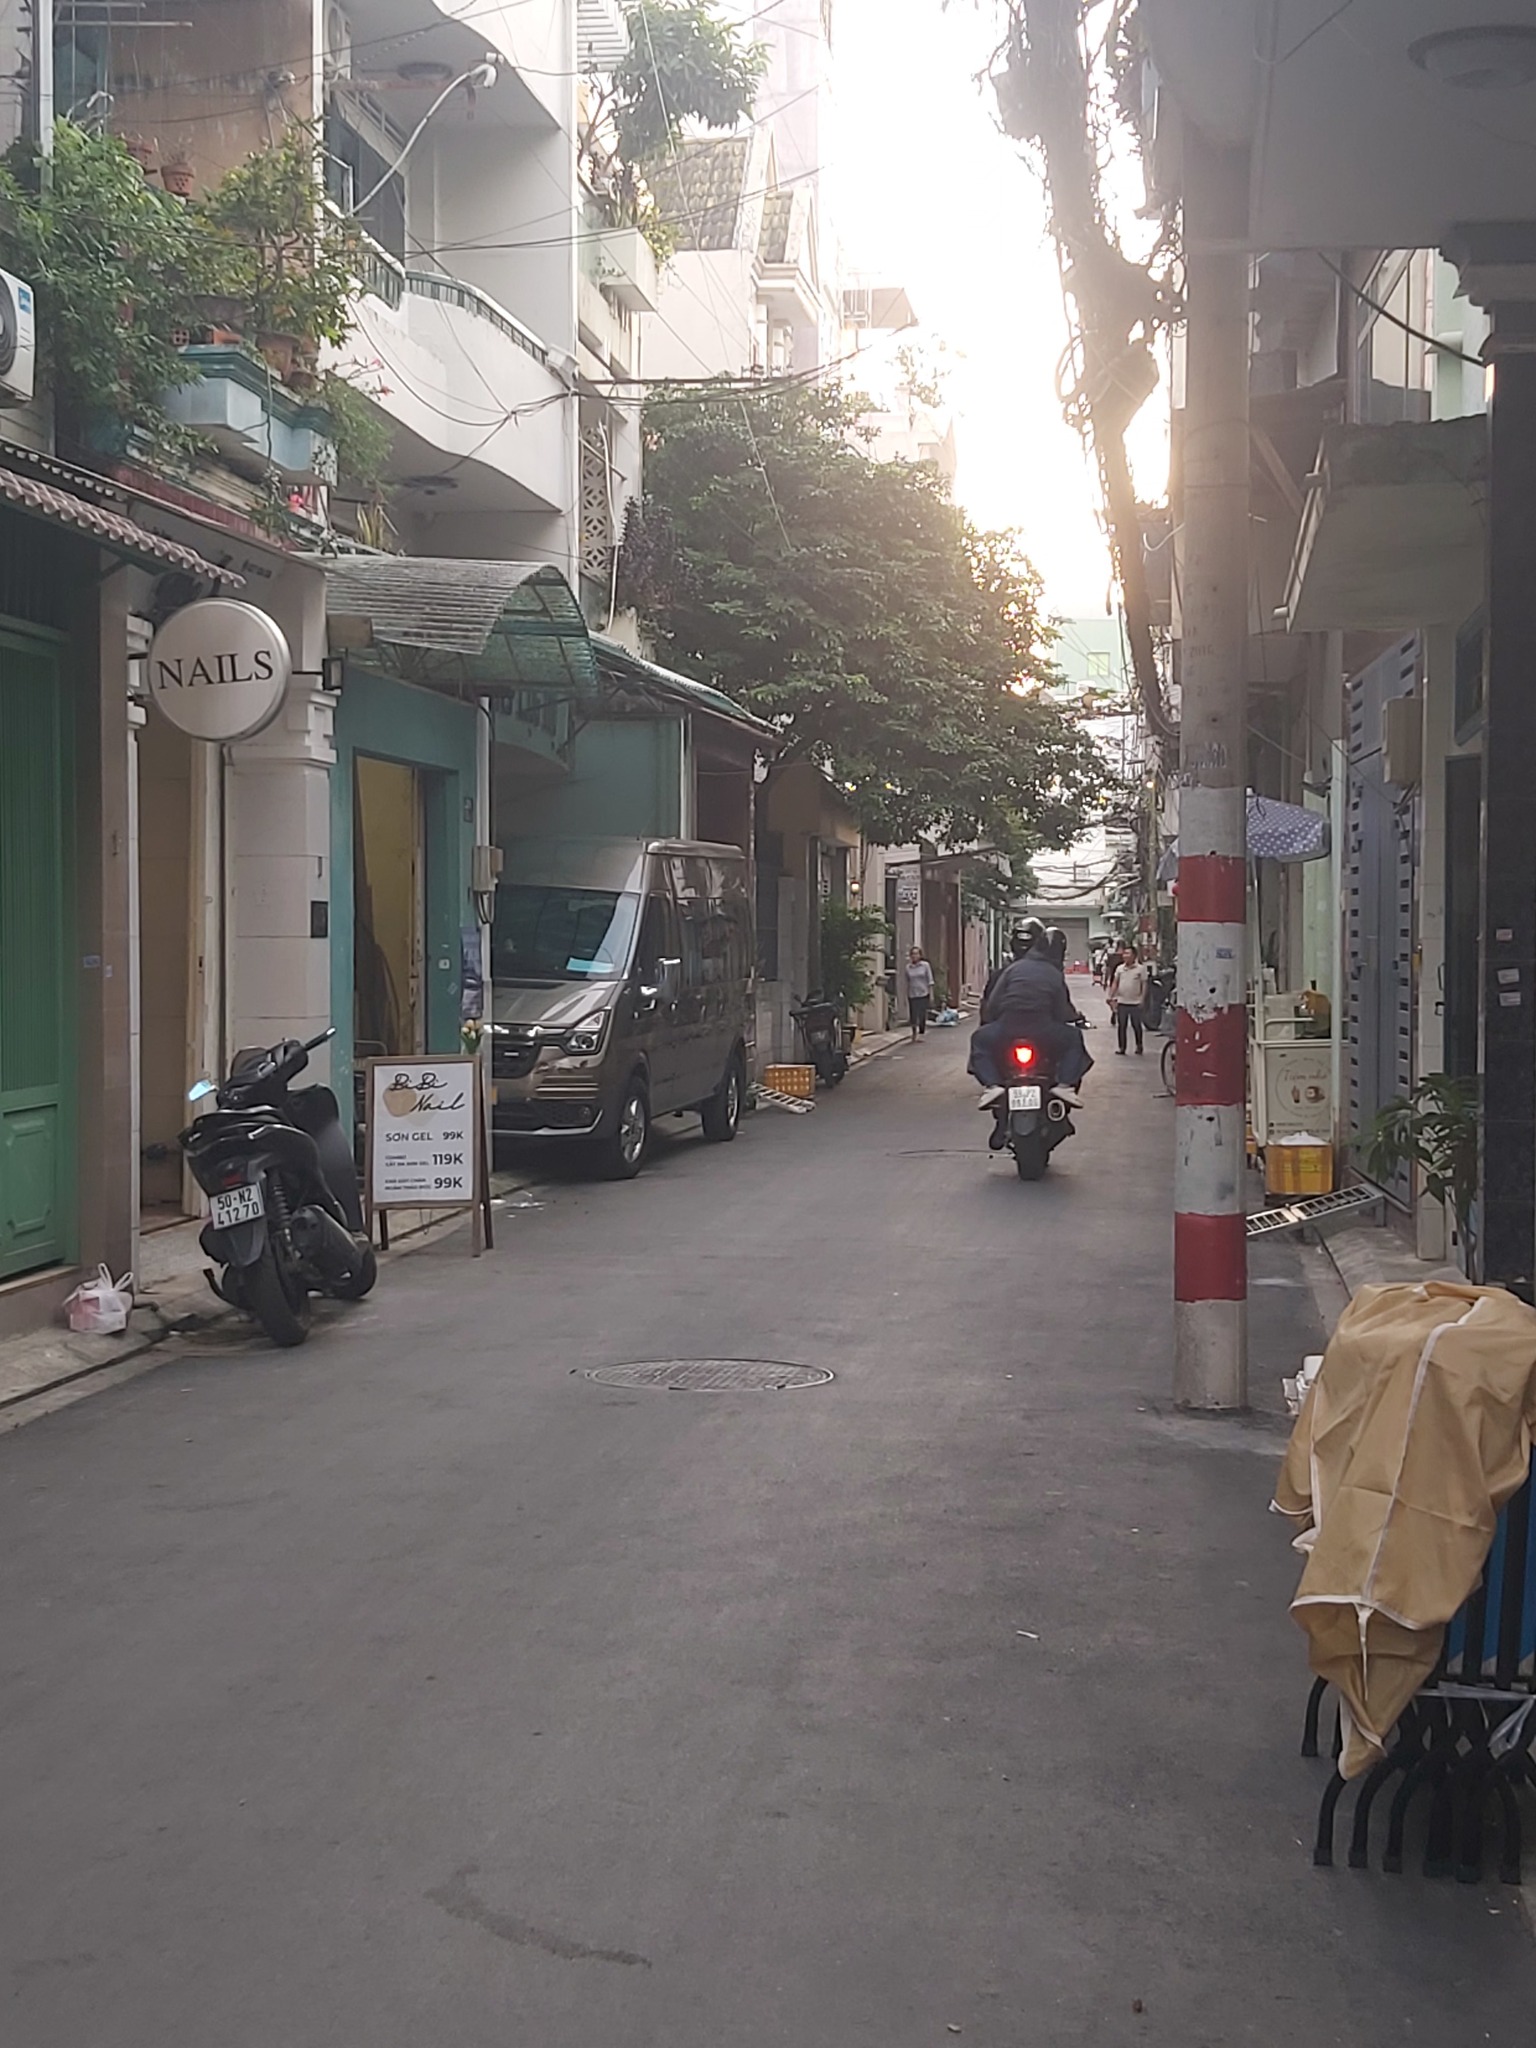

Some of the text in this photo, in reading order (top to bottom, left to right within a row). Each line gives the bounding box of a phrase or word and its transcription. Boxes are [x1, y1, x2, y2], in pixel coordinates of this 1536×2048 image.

[155, 650, 273, 690] NAILS
[410, 1092, 466, 1113] Nail
[412, 1131, 434, 1141] GEL
[443, 1131, 464, 1141] 99K
[432, 1153, 464, 1166] 119K
[434, 1176, 463, 1189] 99K
